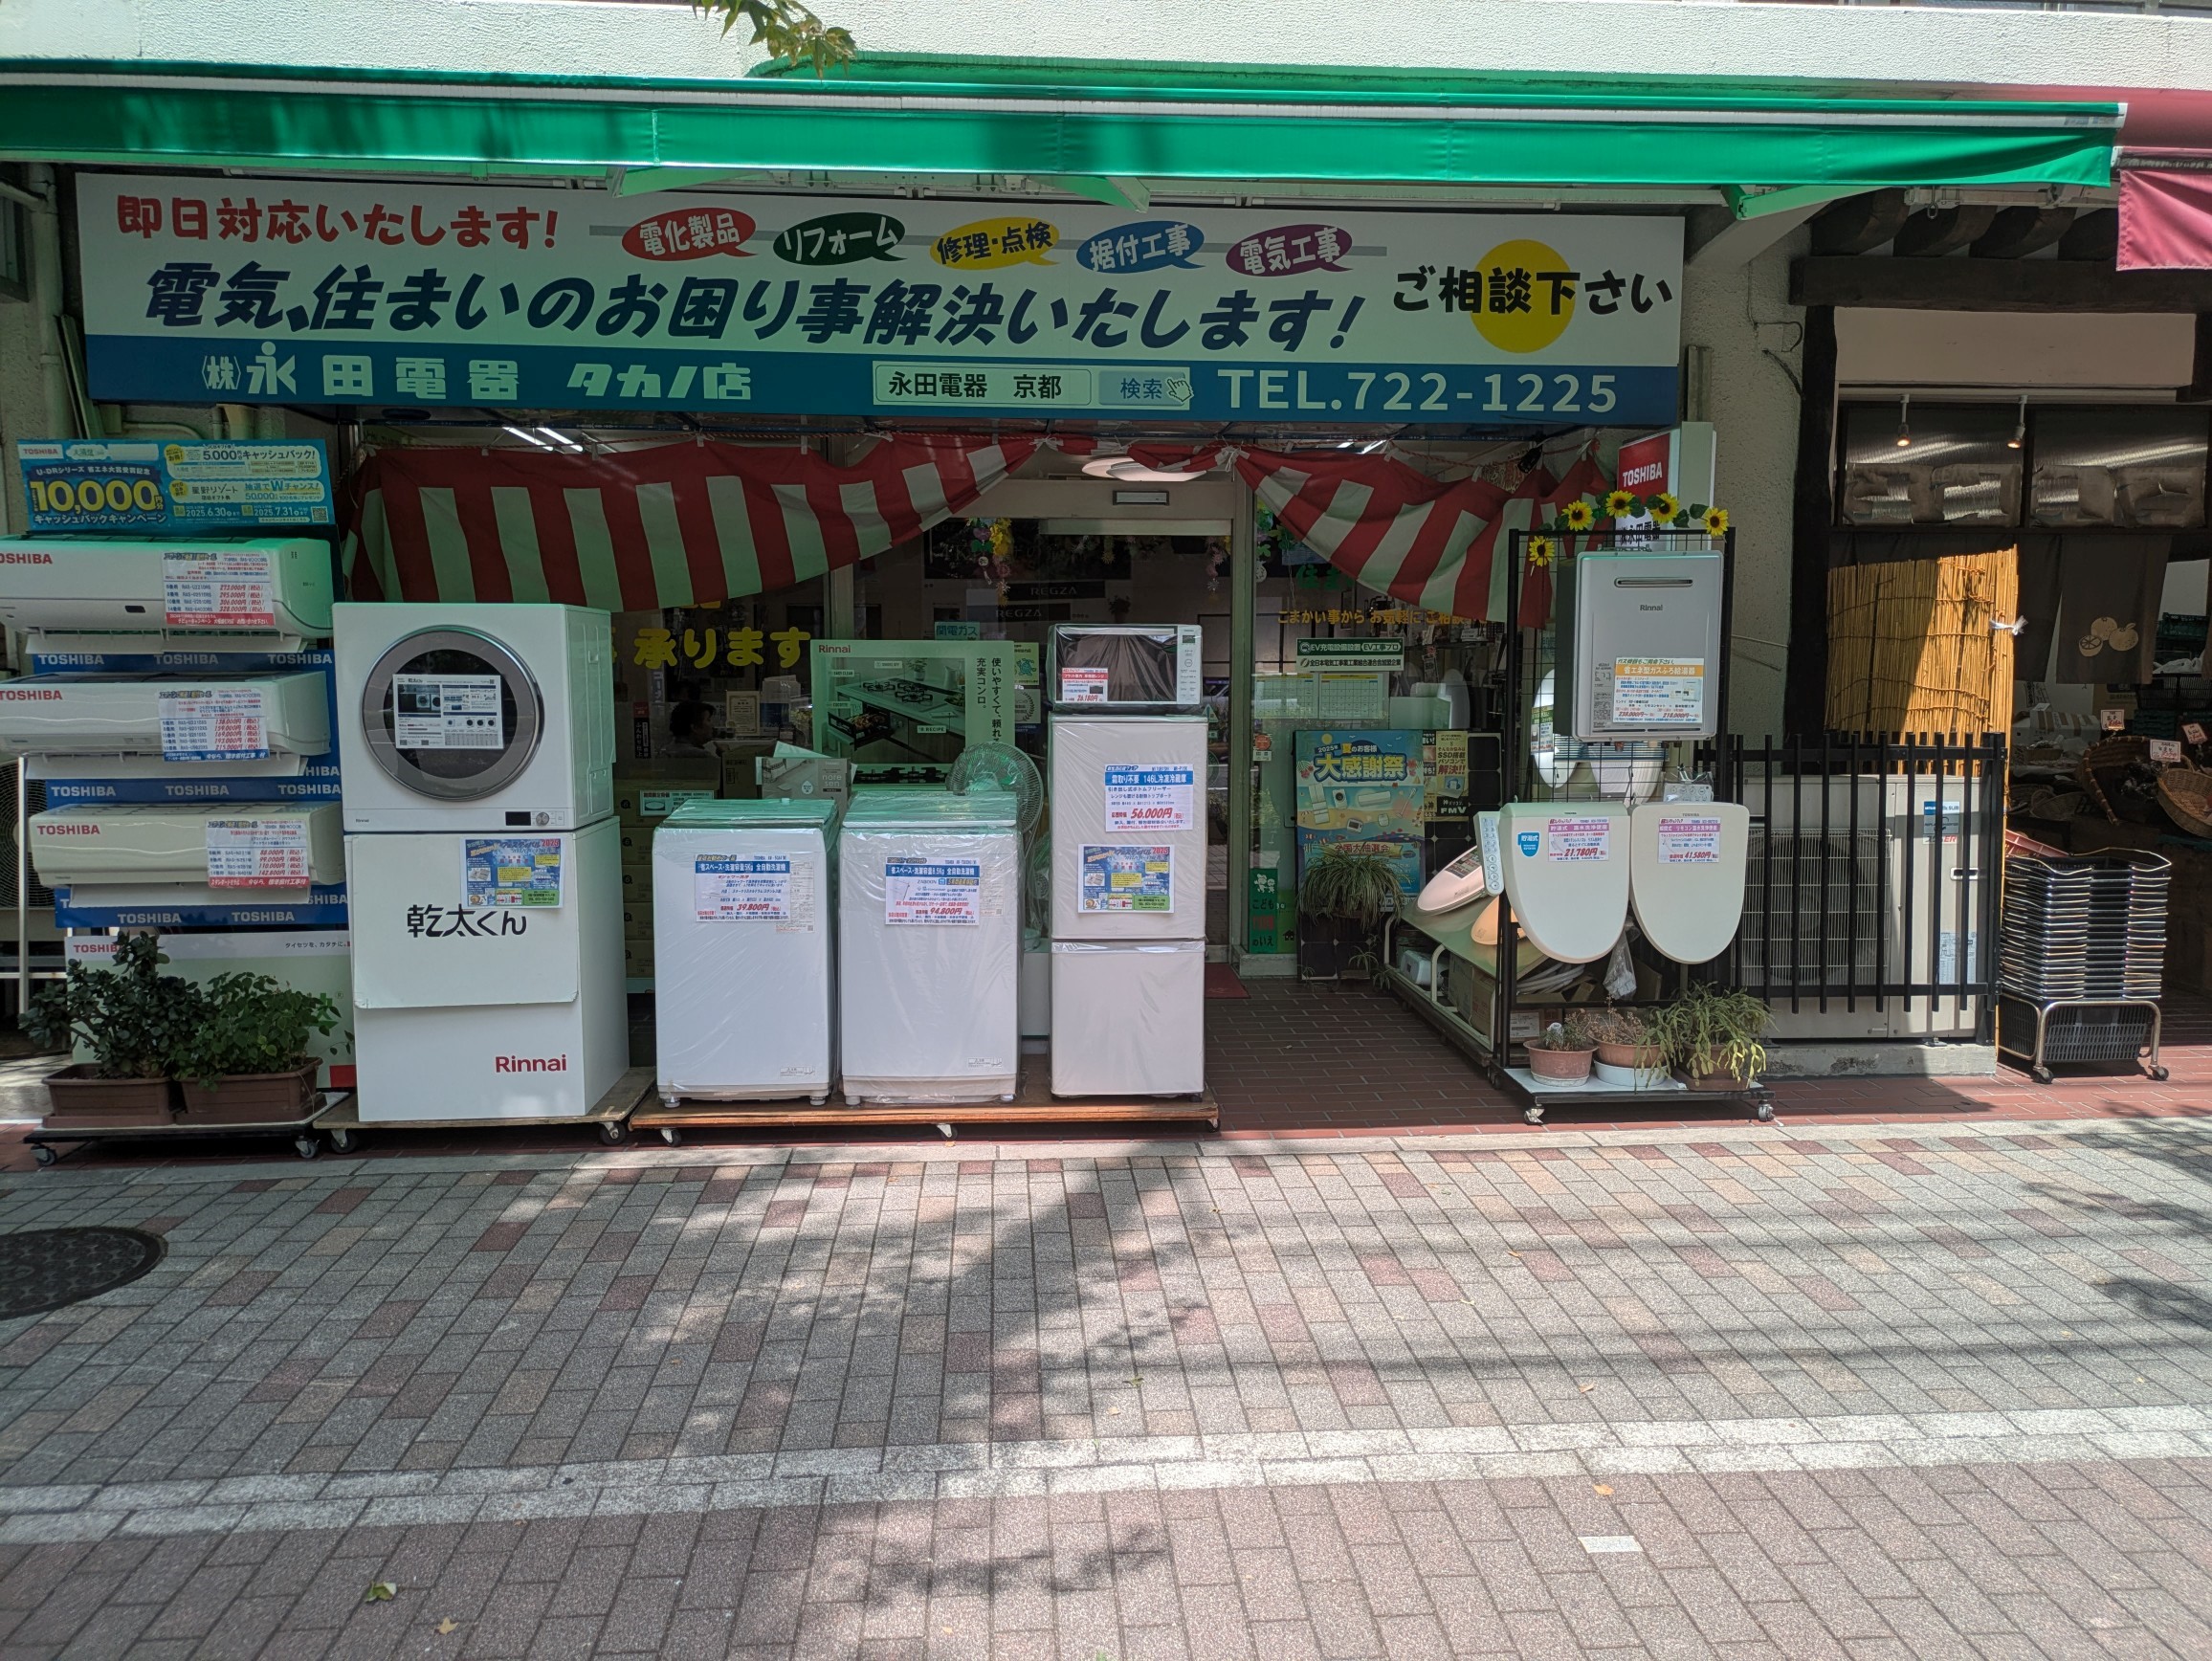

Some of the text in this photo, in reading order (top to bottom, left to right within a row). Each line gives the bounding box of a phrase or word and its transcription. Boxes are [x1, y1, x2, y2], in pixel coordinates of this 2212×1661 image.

[117, 194, 558, 250] 即日対応いたします!
[639, 213, 741, 255] 電化製品
[781, 218, 899, 262] リフォーム
[1090, 222, 1193, 272] 据付工事
[1241, 225, 1342, 275] 電気工事
[1391, 266, 1673, 316] ご相談下さい
[566, 362, 752, 401] タカノ店
[888, 369, 1063, 399] 永田電器 京都
[1119, 376, 1162, 400] 検索
[1218, 367, 1617, 413] TEL.722-1225
[1622, 461, 1663, 488] TOSHIBA
[30, 479, 160, 514] 10,000
[33, 514, 167, 525] キャッシュバックキャンペーン
[996, 609, 1042, 618] REGZA
[1277, 609, 1365, 625] こまかい事から
[1370, 609, 1420, 625] お気軽に
[936, 625, 978, 637] 関電ガス
[633, 627, 812, 669] 承ります
[818, 644, 852, 653] Rinnai
[38, 653, 332, 665] TOSHIBA TOSHIBA TOSHIBA
[1624, 666, 1695, 675] 省エネ型ガスふろ給湯器
[976, 657, 987, 709] 充実コンロ。
[0, 691, 62, 700] TOSHIBA
[991, 657, 1003, 742] 使いやすくて、頼れ
[1341, 742, 1378, 754] 夏のお客様
[303, 766, 340, 776] HIBA
[1314, 753, 1406, 781] 大感謝祭
[52, 785, 341, 797] TOSHIBA TOSHIBA TOSHIBA
[37, 825, 100, 835] TOSHIBA
[307, 895, 347, 904] SHIBA
[1251, 899, 1274, 909] こども
[118, 912, 295, 923] TOSHIBA TOSHIBA
[407, 903, 527, 938] 乾太くん
[74, 944, 118, 953] TOSHIB
[495, 1054, 567, 1073] Rinnai
